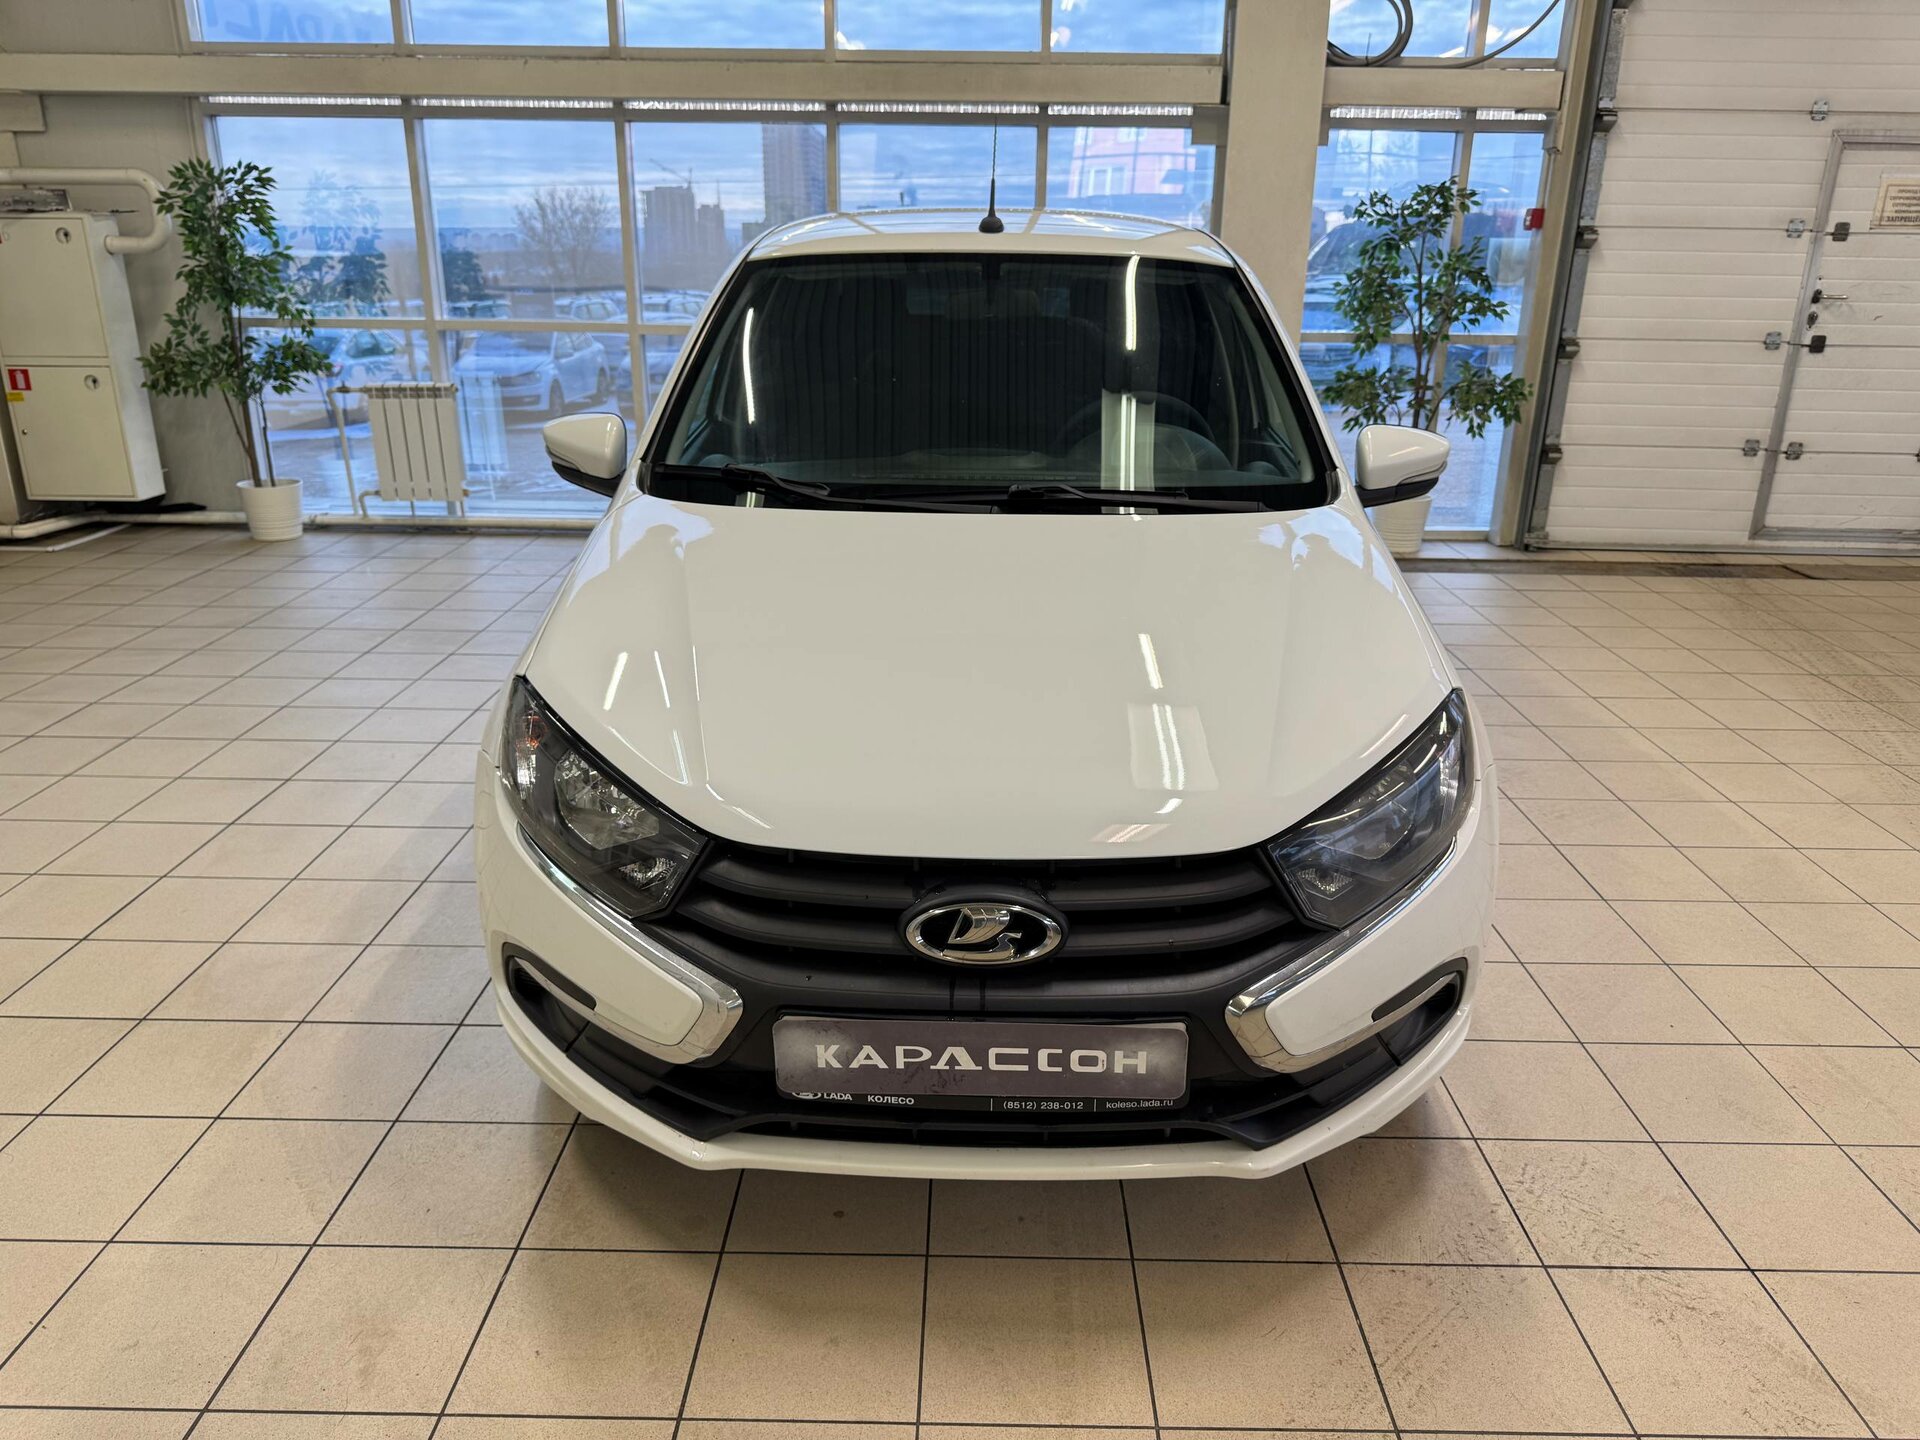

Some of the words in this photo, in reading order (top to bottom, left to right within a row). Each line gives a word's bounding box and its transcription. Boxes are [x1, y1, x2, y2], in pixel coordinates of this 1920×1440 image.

[823, 1092, 853, 1101] LADA
[867, 1094, 915, 1105] КОЛЕСО
[1003, 1101, 1037, 1110] (8512)
[1040, 1102, 1084, 1110] 238-012
[1105, 1099, 1174, 1109] koleso.lada.ru
